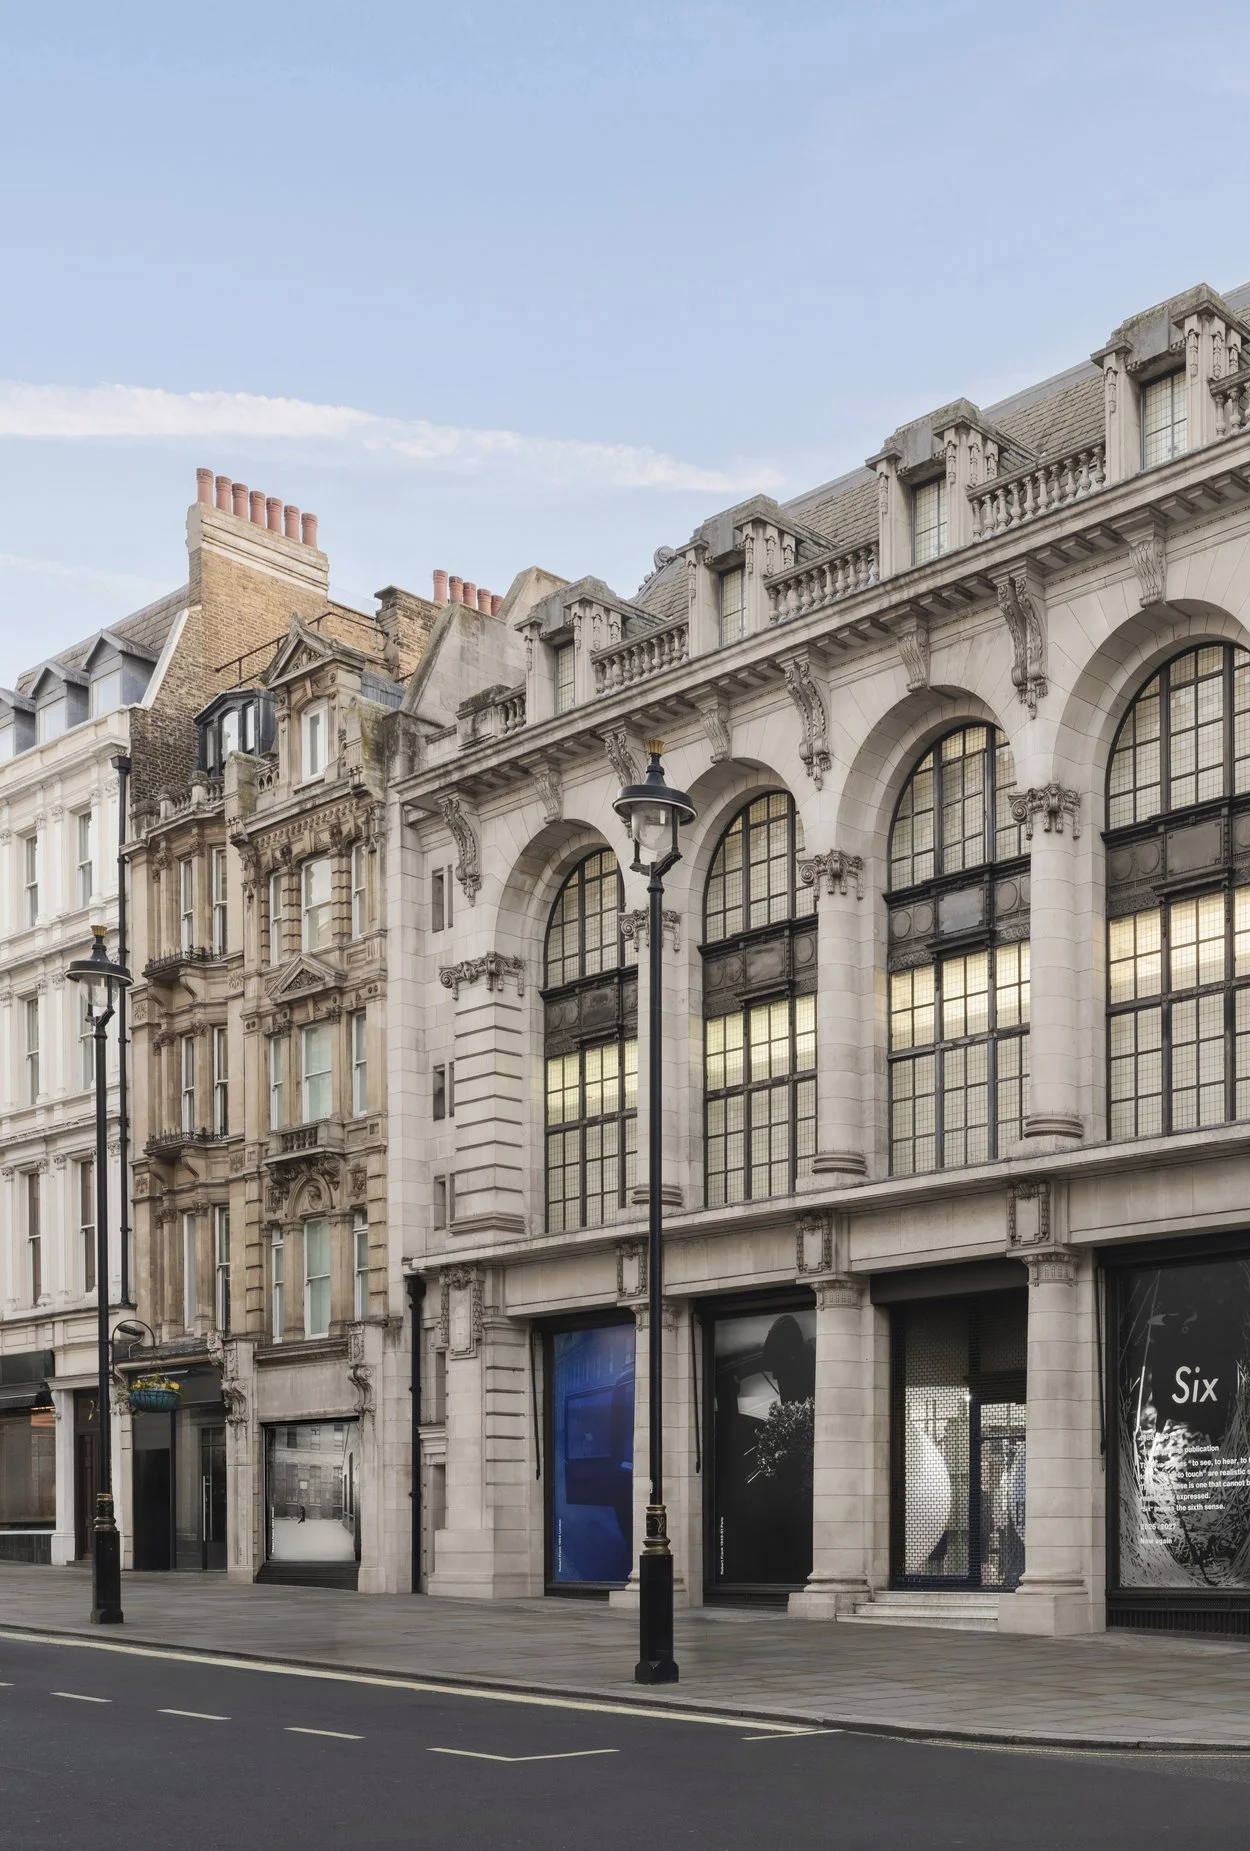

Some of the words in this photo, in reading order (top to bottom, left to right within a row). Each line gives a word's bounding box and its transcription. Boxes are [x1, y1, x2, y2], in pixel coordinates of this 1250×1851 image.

[1171, 1366, 1219, 1404] Six
[1184, 1444, 1220, 1455] publication
[1199, 1459, 1214, 1467] see,
[1222, 1457, 1240, 1466] hear,
[1240, 1456, 1248, 1464] to
[1219, 1468, 1246, 1476] realistic
[1188, 1481, 1195, 1489] is
[1208, 1480, 1222, 1488] that
[1222, 1479, 1246, 1487] cannot
[1176, 1492, 1211, 1502] expressed.
[1176, 1504, 1187, 1512] the
[1187, 1503, 1204, 1511] sixth
[1204, 1503, 1226, 1511] sense.
[1155, 1537, 1173, 1546] again
